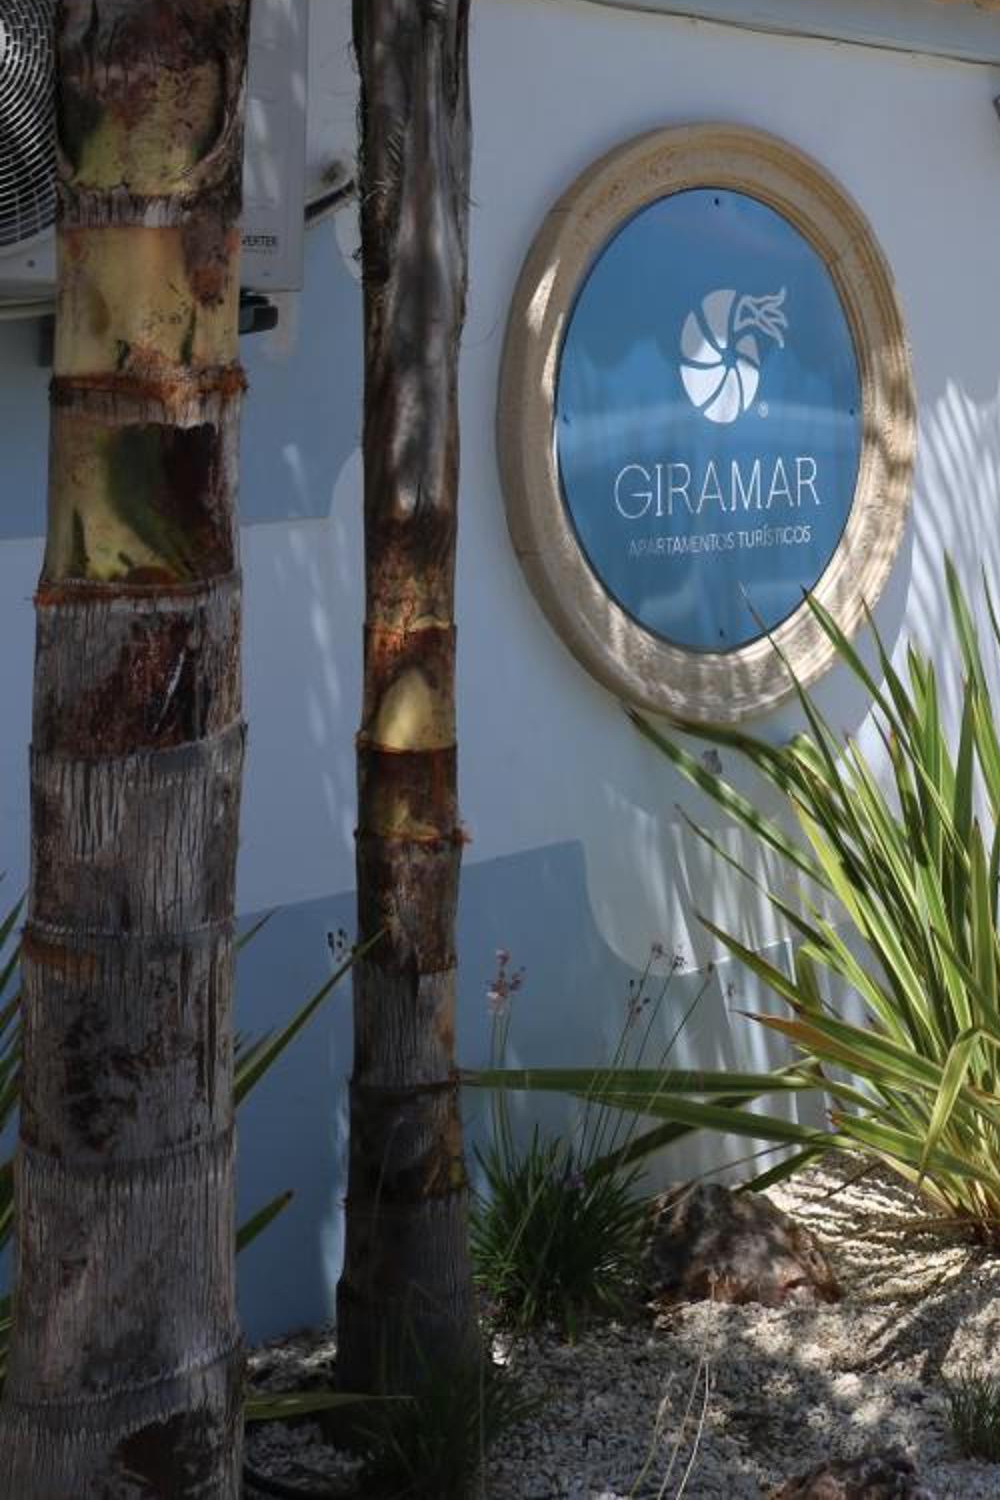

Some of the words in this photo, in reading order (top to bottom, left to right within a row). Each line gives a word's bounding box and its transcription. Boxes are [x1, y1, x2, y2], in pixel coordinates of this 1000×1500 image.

[614, 457, 821, 520] GIRAMAR
[630, 532, 735, 556] APARTAMENTOS
[738, 523, 812, 549] TURÍSTICOS
